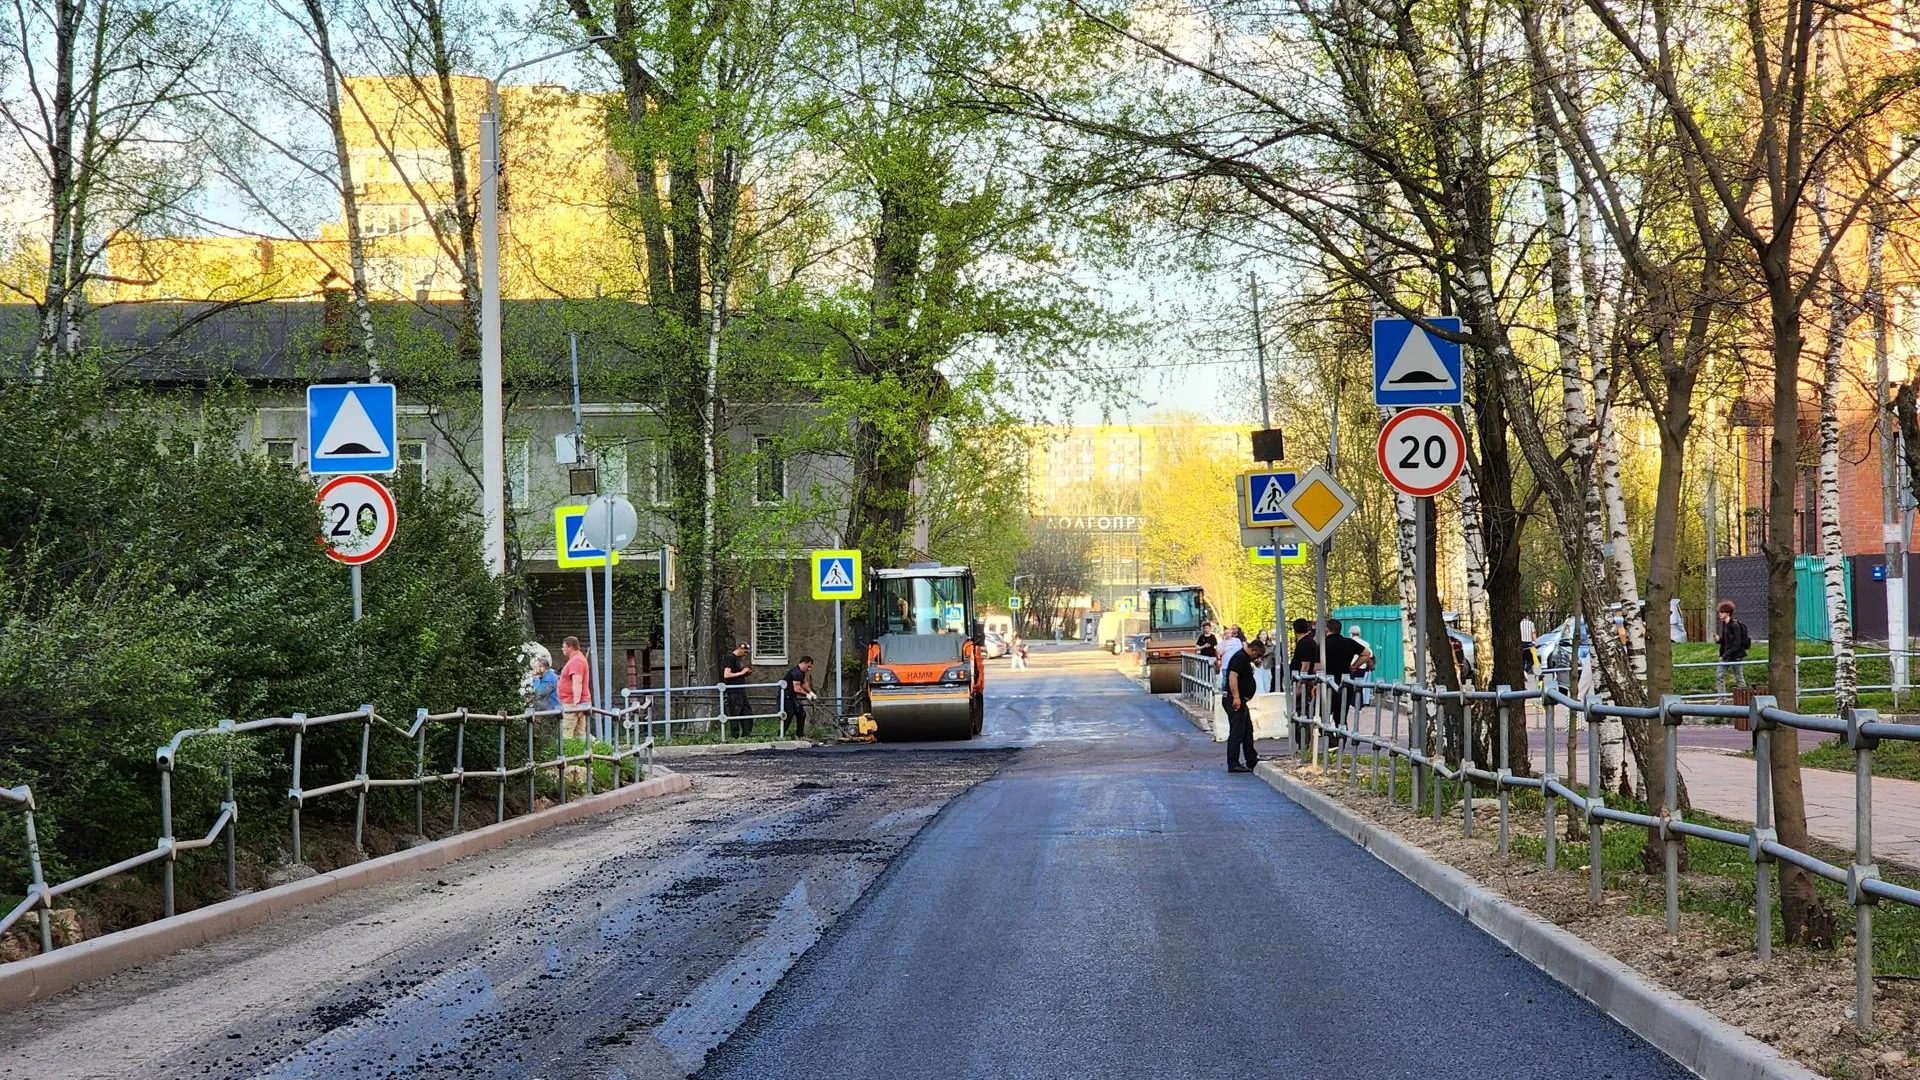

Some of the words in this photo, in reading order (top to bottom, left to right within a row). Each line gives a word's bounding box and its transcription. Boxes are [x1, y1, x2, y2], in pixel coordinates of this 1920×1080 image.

[1399, 435, 1446, 469] 20
[327, 503, 378, 537] 20
[907, 671, 933, 679] HAMM
